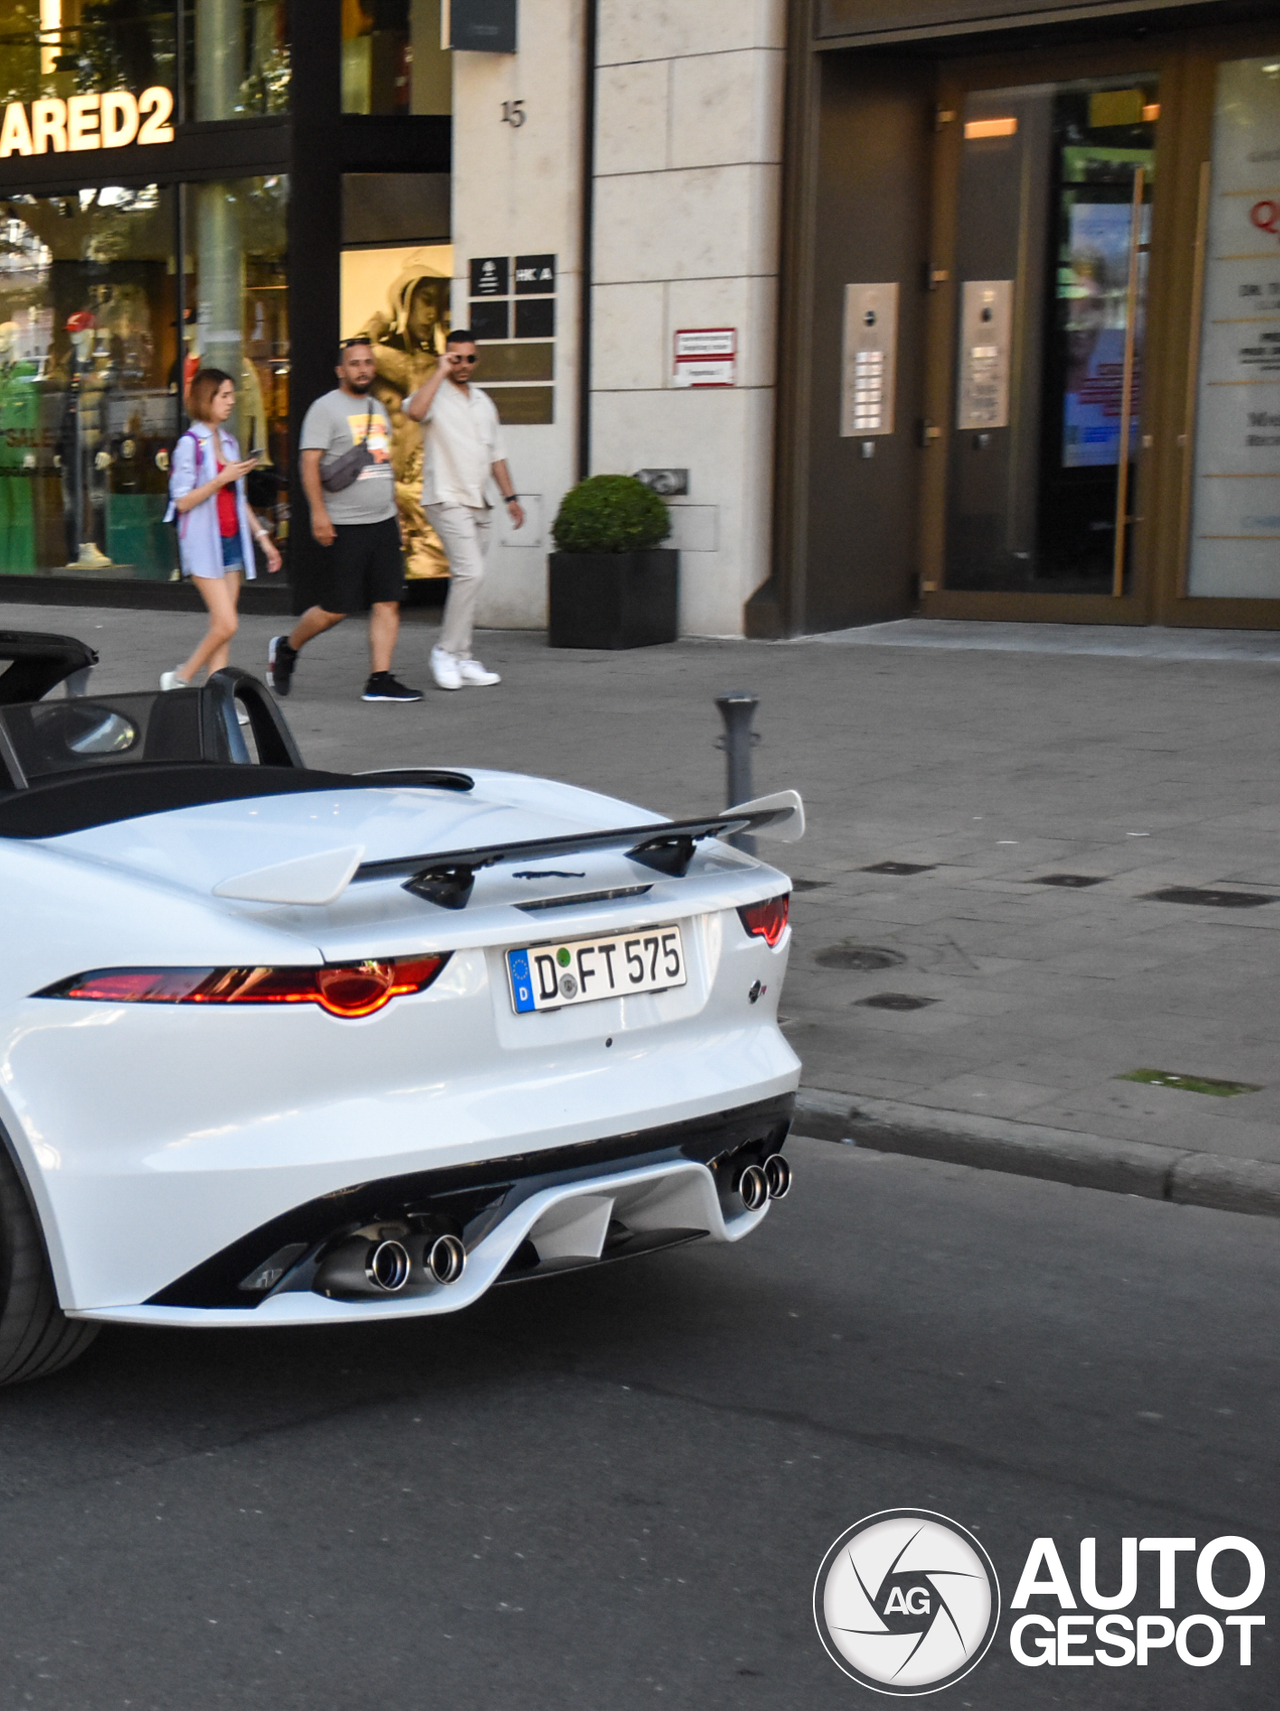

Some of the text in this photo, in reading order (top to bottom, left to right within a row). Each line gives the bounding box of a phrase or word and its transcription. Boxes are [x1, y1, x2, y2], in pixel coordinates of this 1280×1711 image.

[499, 99, 527, 129] 15
[535, 933, 681, 1001] D FT 575
[518, 986, 528, 1002] D
